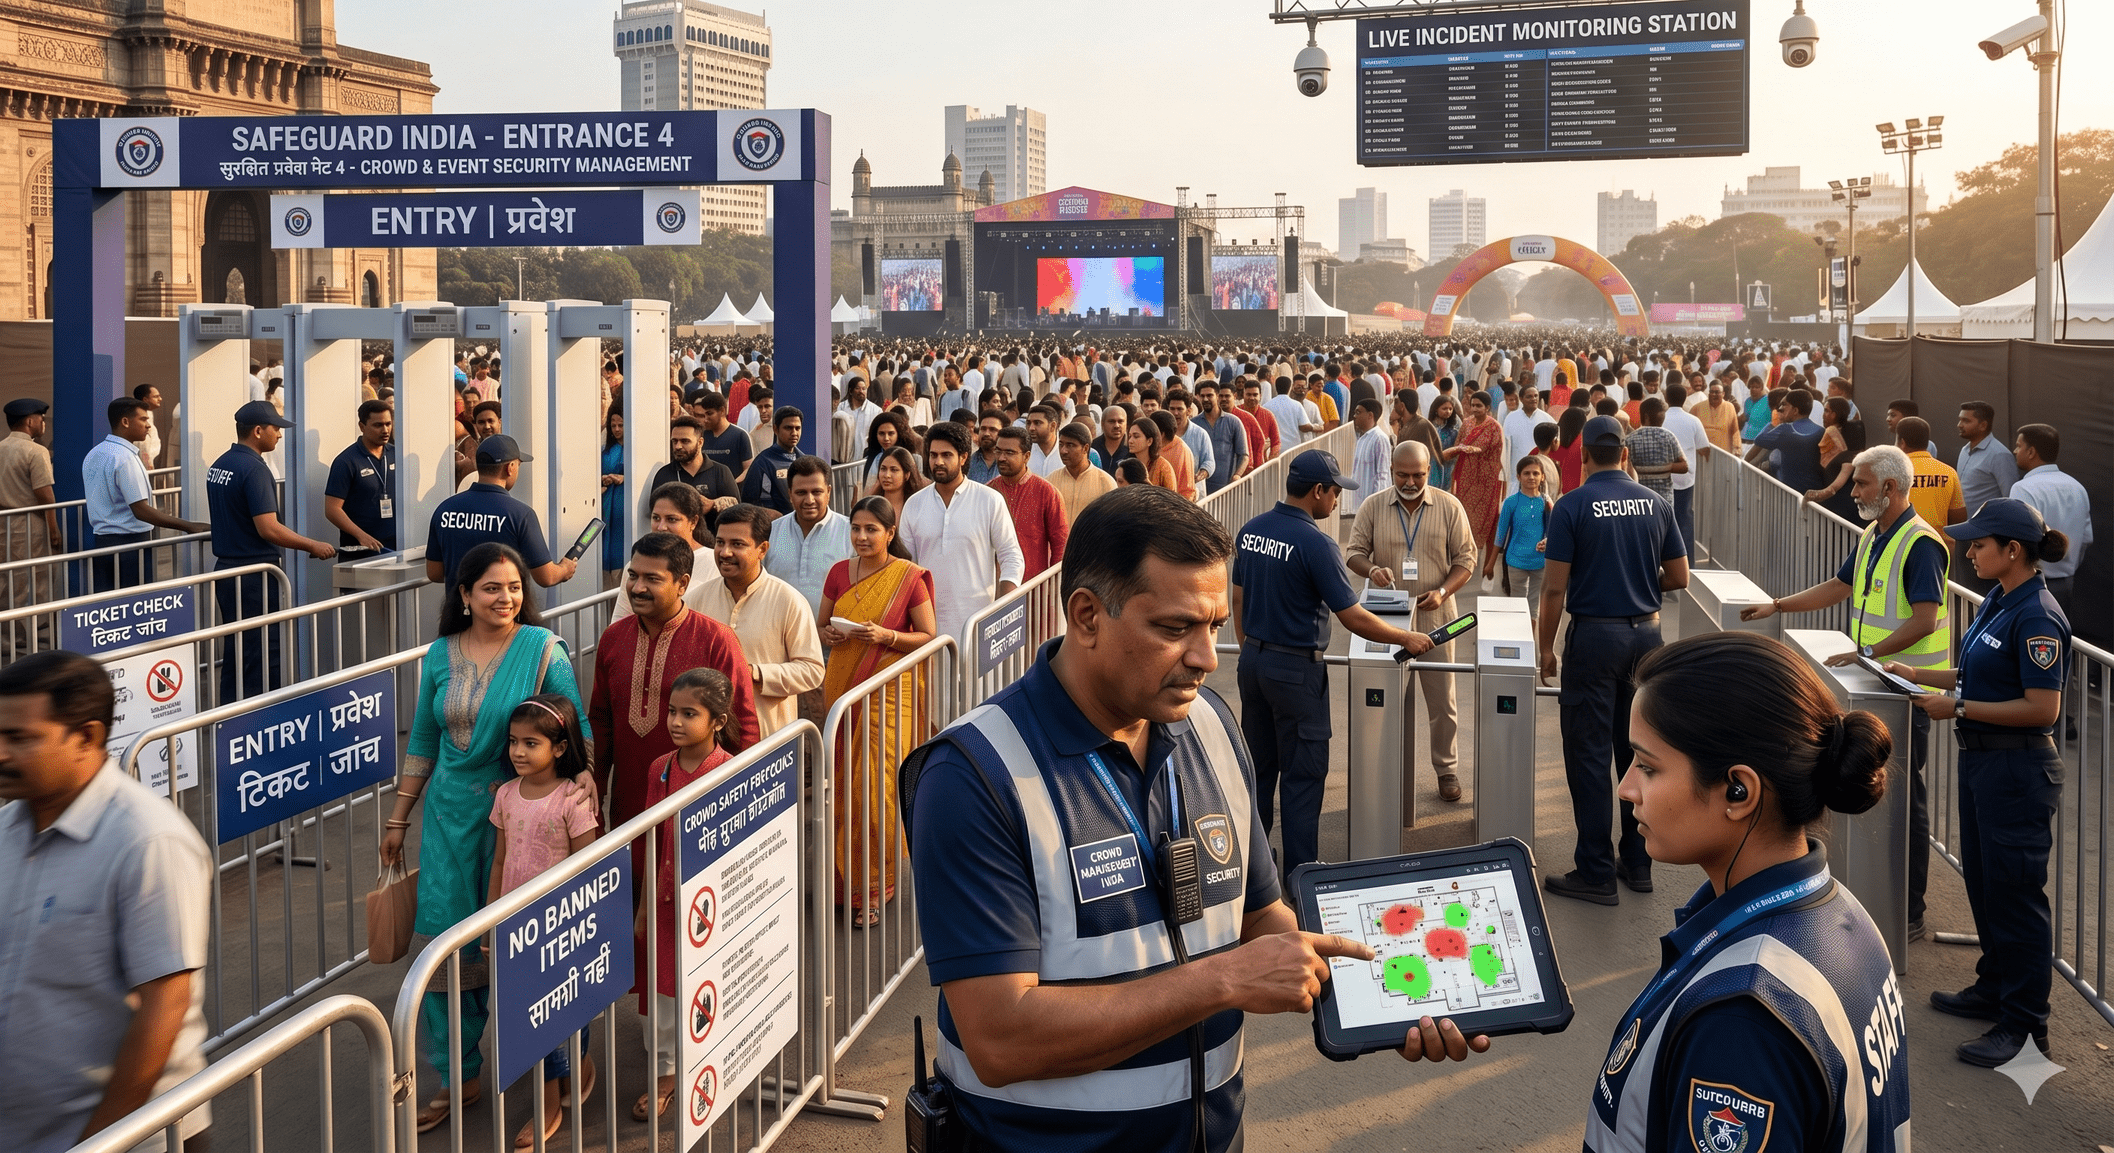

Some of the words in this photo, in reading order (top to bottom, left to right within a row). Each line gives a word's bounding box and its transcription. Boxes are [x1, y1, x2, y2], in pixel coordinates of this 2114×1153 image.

[1368, 29, 1410, 48] LIVE
[1416, 23, 1507, 46] INCIDENT
[1512, 16, 1642, 41] MONITORING
[1648, 11, 1737, 33] STATION
[231, 125, 393, 151] SAFEGUARD
[402, 124, 477, 150] INDIA
[503, 122, 650, 149] ENTRANCE
[657, 122, 674, 147] 4
[335, 160, 345, 174] 4
[360, 160, 418, 175] CROWD
[422, 160, 433, 174] &
[438, 158, 489, 174] EVENT
[492, 157, 571, 174] SECURITY
[576, 156, 692, 173] MANAGEMENT
[371, 206, 477, 235] ENTRY
[506, 197, 576, 235] प्रवेश
[440, 511, 507, 533] SECURITY
[1592, 499, 1654, 518] SECURITY
[1241, 533, 1294, 562] SECURITY
[74, 603, 130, 628] TICKET
[133, 593, 183, 616] CHECK
[91, 625, 132, 648] टिकट
[135, 617, 168, 636] जांच
[229, 714, 312, 765] ENTRY
[329, 690, 383, 732] प्रवेश
[236, 760, 311, 813] टिकट
[329, 735, 382, 775] जांच
[684, 801, 717, 834] CROWD
[719, 779, 749, 812] SAFETY
[1090, 846, 1123, 863] CROWD
[1206, 867, 1240, 885] SECURITY
[509, 918, 539, 960] NO
[545, 866, 621, 935] BANNED
[540, 912, 597, 973] ITEMS
[583, 941, 611, 985] नहीं
[1864, 966, 1906, 1096] STAFF
